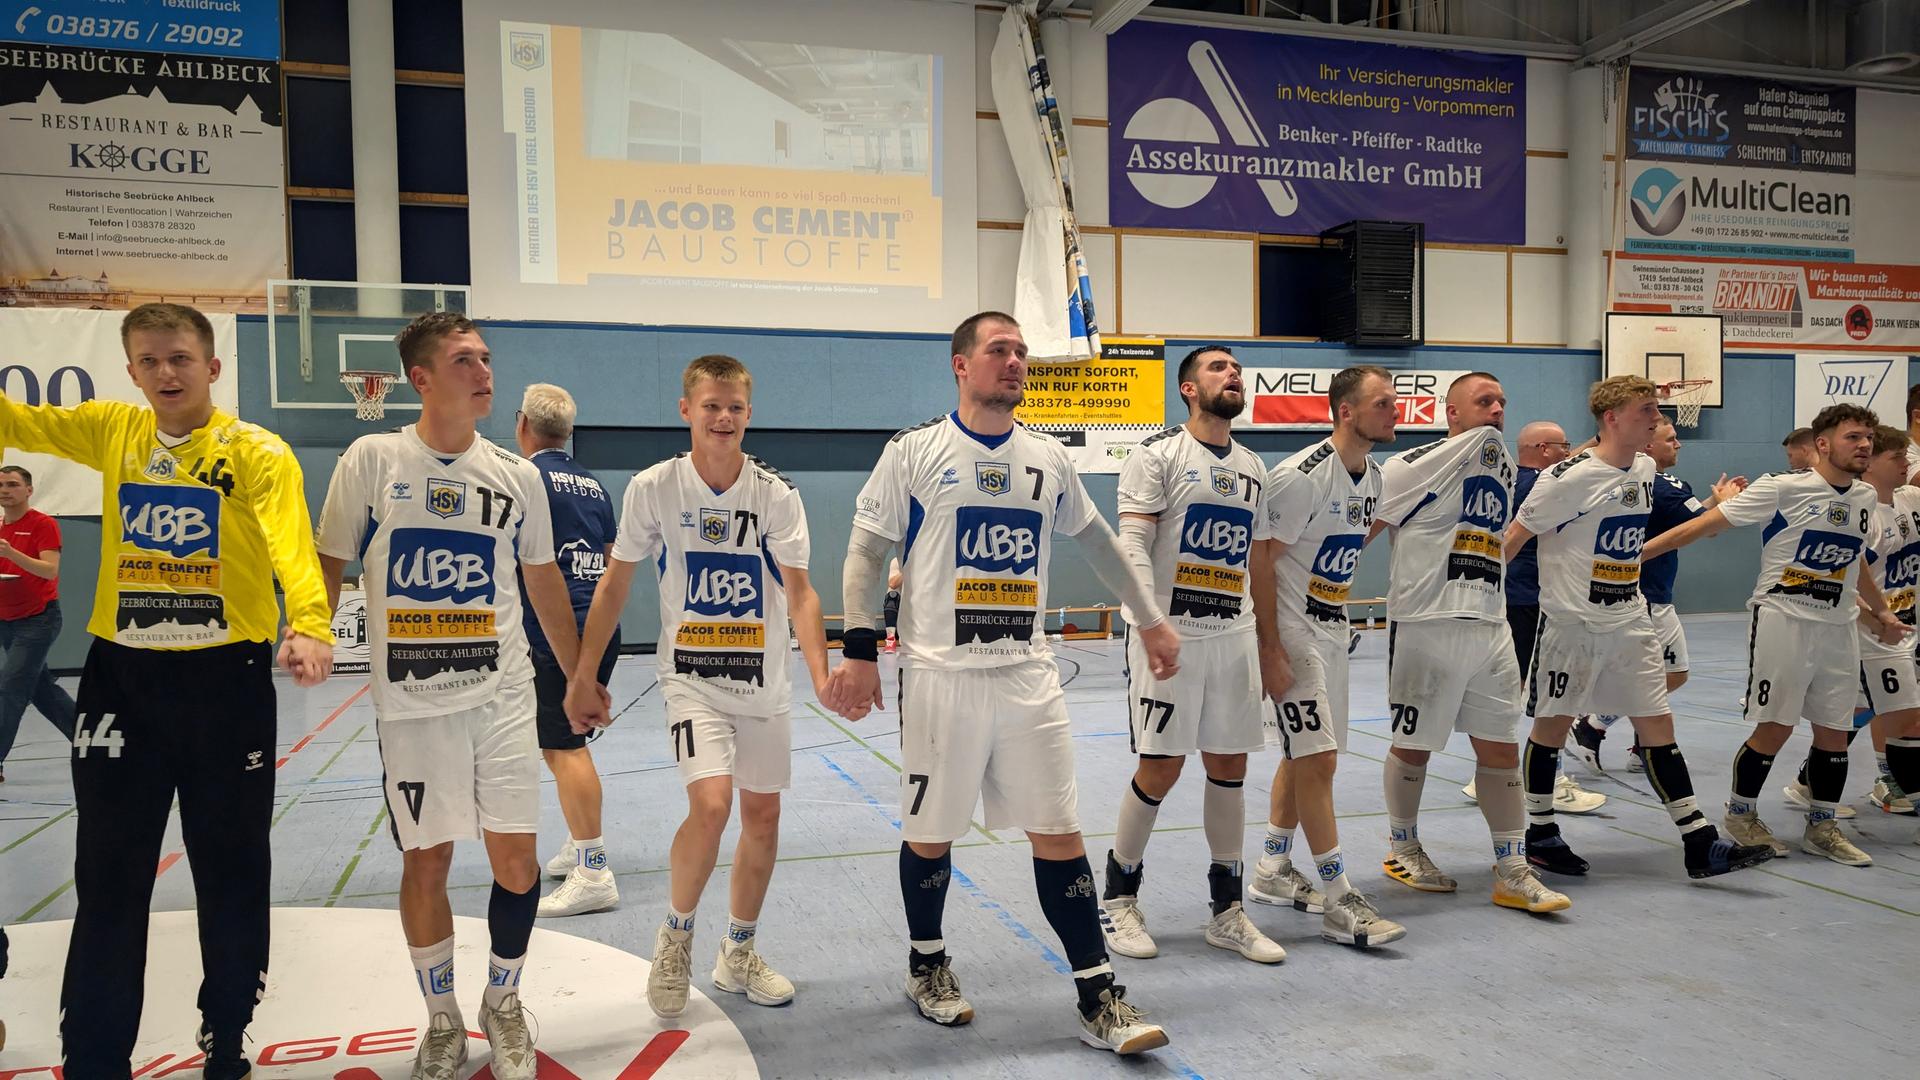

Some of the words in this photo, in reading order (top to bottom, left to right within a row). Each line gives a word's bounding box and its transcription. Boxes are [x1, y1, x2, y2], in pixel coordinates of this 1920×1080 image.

[162, 0, 241, 12] Textildruck
[46, 14, 140, 40] 038376
[164, 23, 244, 47] 29092
[0, 48, 145, 75] SEEBRÜCKE
[156, 59, 272, 84] AHLBECK
[1319, 63, 1340, 82] Ihr
[1347, 67, 1514, 95] Versicherungsmakler
[1278, 84, 1292, 101] in
[1297, 85, 1400, 113] Mecklenburg
[1413, 96, 1515, 118] Vorpommern
[1759, 88, 1786, 102] Hafen
[524, 87, 537, 133] USEDOM
[1744, 102, 1759, 115] auf
[1761, 103, 1780, 117] dem
[1783, 105, 1845, 124] Campingplatz
[41, 113, 169, 136] RESTAURANT
[177, 123, 190, 137] &
[198, 123, 233, 139] BAR
[1279, 124, 1338, 145] Benker
[1352, 132, 1413, 150] Pfeiffer
[1425, 136, 1482, 155] Radtke
[1638, 141, 1687, 155] HAFENLOUNGE
[1690, 144, 1726, 158] STAGNIESS
[526, 136, 537, 166] INSEL
[1737, 144, 1786, 162] SCHLEMMEN
[1801, 150, 1851, 166] ENTSPANNEN
[1127, 143, 1395, 184] Assekuranzmakler
[1404, 163, 1483, 189] GmbH
[527, 169, 538, 191] HSV
[65, 188, 121, 200] Historische
[123, 190, 174, 202] Seebrücke
[176, 194, 215, 204] Ahlbeck
[528, 194, 539, 214] DES
[696, 184, 736, 198] Bauen
[739, 186, 771, 199] kann
[774, 190, 789, 201] so
[792, 188, 814, 202] viel
[817, 191, 847, 206] Spaß
[850, 193, 901, 207] machen!
[1691, 176, 1850, 216] MultiClean
[48, 203, 99, 214] Restaurant
[107, 205, 167, 217] Eventlocation
[175, 208, 232, 219] Wahrzeichen
[608, 199, 736, 231] JACOB
[752, 206, 900, 240] CEMENT
[1691, 213, 1711, 222] IHRE
[1715, 215, 1763, 225] USEDOMER
[1766, 217, 1849, 229] REINIGUNGSPROFIS
[88, 218, 123, 228] Telefon
[131, 220, 165, 230] 038378
[167, 221, 195, 231] 28320
[1691, 227, 1703, 235] +49
[1705, 227, 1714, 236] (0)
[1716, 228, 1729, 236] 172
[1770, 231, 1849, 243] www.mc-multiclean.de
[58, 231, 88, 241] E-Mail
[96, 232, 225, 247] info@seebruecke-ahlbeck.de
[528, 217, 540, 264] PARTNER
[56, 247, 94, 257] Internet
[101, 249, 228, 262] www.seebruecke-ahlbeck.de
[607, 232, 901, 272] BAUSTOFFE
[1632, 264, 1671, 273] Swinemünder
[1639, 274, 1656, 282] 17419
[1720, 268, 1729, 278] Ihr
[1731, 269, 1757, 279] Partner
[1778, 271, 1798, 281] Dach!
[1810, 269, 1830, 281] Wir
[1833, 270, 1866, 282] bauen
[1868, 271, 1888, 283] mit
[1714, 281, 1796, 310] BRANDT
[1817, 285, 1903, 300] Markenqualität
[1733, 327, 1793, 338] Dachdeckerei
[1811, 317, 1824, 326] DAS
[1825, 317, 1843, 326] DACH
[1875, 318, 1895, 328] STARK
[1896, 320, 1908, 328] WIE
[1028, 367, 1081, 377] NSPORT
[1085, 367, 1138, 378] SOFORT,
[1053, 382, 1079, 391] RUF
[1083, 382, 1128, 392] KORTH
[1825, 375, 1869, 396] DRL
[189, 457, 235, 497] 44
[980, 472, 1006, 490] HSV
[1025, 466, 1044, 500] 7
[1238, 472, 1262, 507] 77
[431, 491, 458, 513] HSV
[476, 487, 514, 530] 17
[122, 503, 211, 545] UBB
[734, 510, 760, 547] 71
[1859, 508, 1869, 534] 8
[960, 522, 1036, 563] UBB
[1185, 518, 1248, 556] UBB
[159, 562, 212, 574] CEMENT
[392, 546, 490, 591] UBB
[1177, 565, 1210, 576] JACOB
[688, 567, 757, 607] UBB
[957, 582, 996, 591] JACOB
[120, 596, 171, 609] SEEBRÜCKE
[172, 598, 219, 610] AHLBECK
[389, 613, 432, 624] JACOB
[436, 613, 489, 624] CEMENT
[389, 624, 490, 634] BAUSTOFFE
[960, 614, 1010, 626] SEEBRÜCKE
[678, 625, 714, 635] JACOB
[392, 648, 449, 660] SEEBRÜCKE
[452, 647, 497, 658] AHLBECK
[677, 654, 726, 667] SEEBRÜCKE
[403, 680, 461, 692] RESTAURANT
[470, 675, 487, 685] BAR
[1548, 670, 1569, 699] 19
[1881, 668, 1900, 694] 6
[1758, 679, 1771, 706] 8
[1140, 697, 1175, 734] 77
[1283, 700, 1321, 733] 93
[1390, 703, 1419, 735] 79
[73, 713, 125, 758] 44
[671, 719, 695, 762] 71
[908, 773, 929, 816] 7
